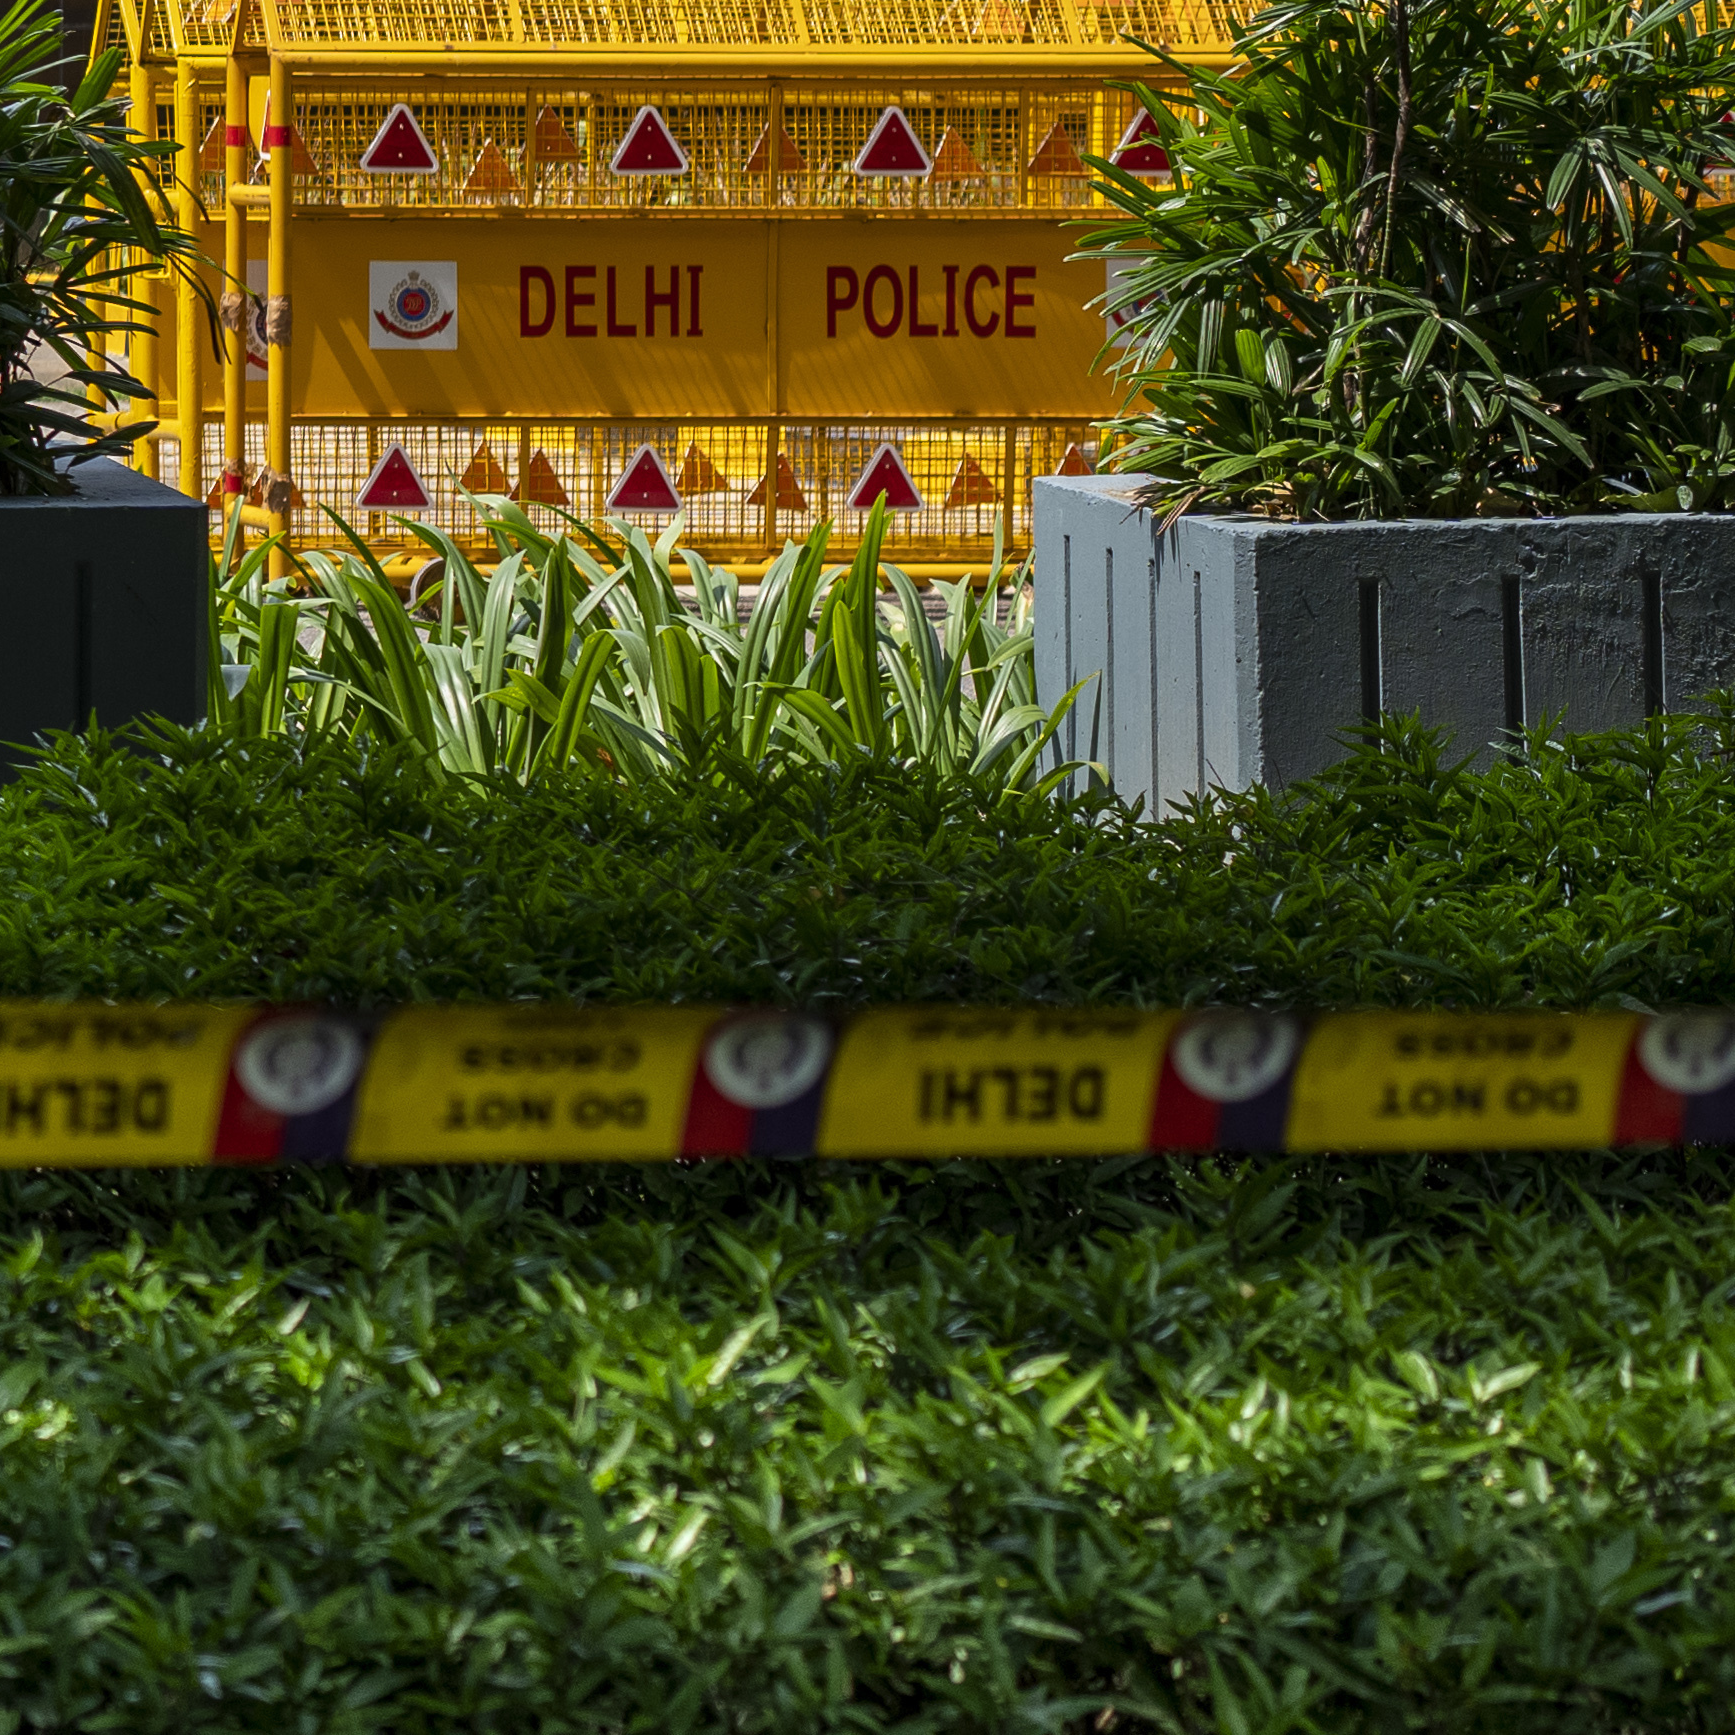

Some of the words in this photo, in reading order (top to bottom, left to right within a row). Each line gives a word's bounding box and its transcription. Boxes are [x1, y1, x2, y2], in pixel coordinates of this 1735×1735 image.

[519, 264, 704, 340] DELHI
[825, 264, 1037, 340] POLICE
[443, 1089, 553, 1132] NOT
[571, 1089, 650, 1130] DO
[917, 1062, 1108, 1125] DELHI
[1375, 1075, 1485, 1121] NOT
[1504, 1075, 1581, 1117] DO
